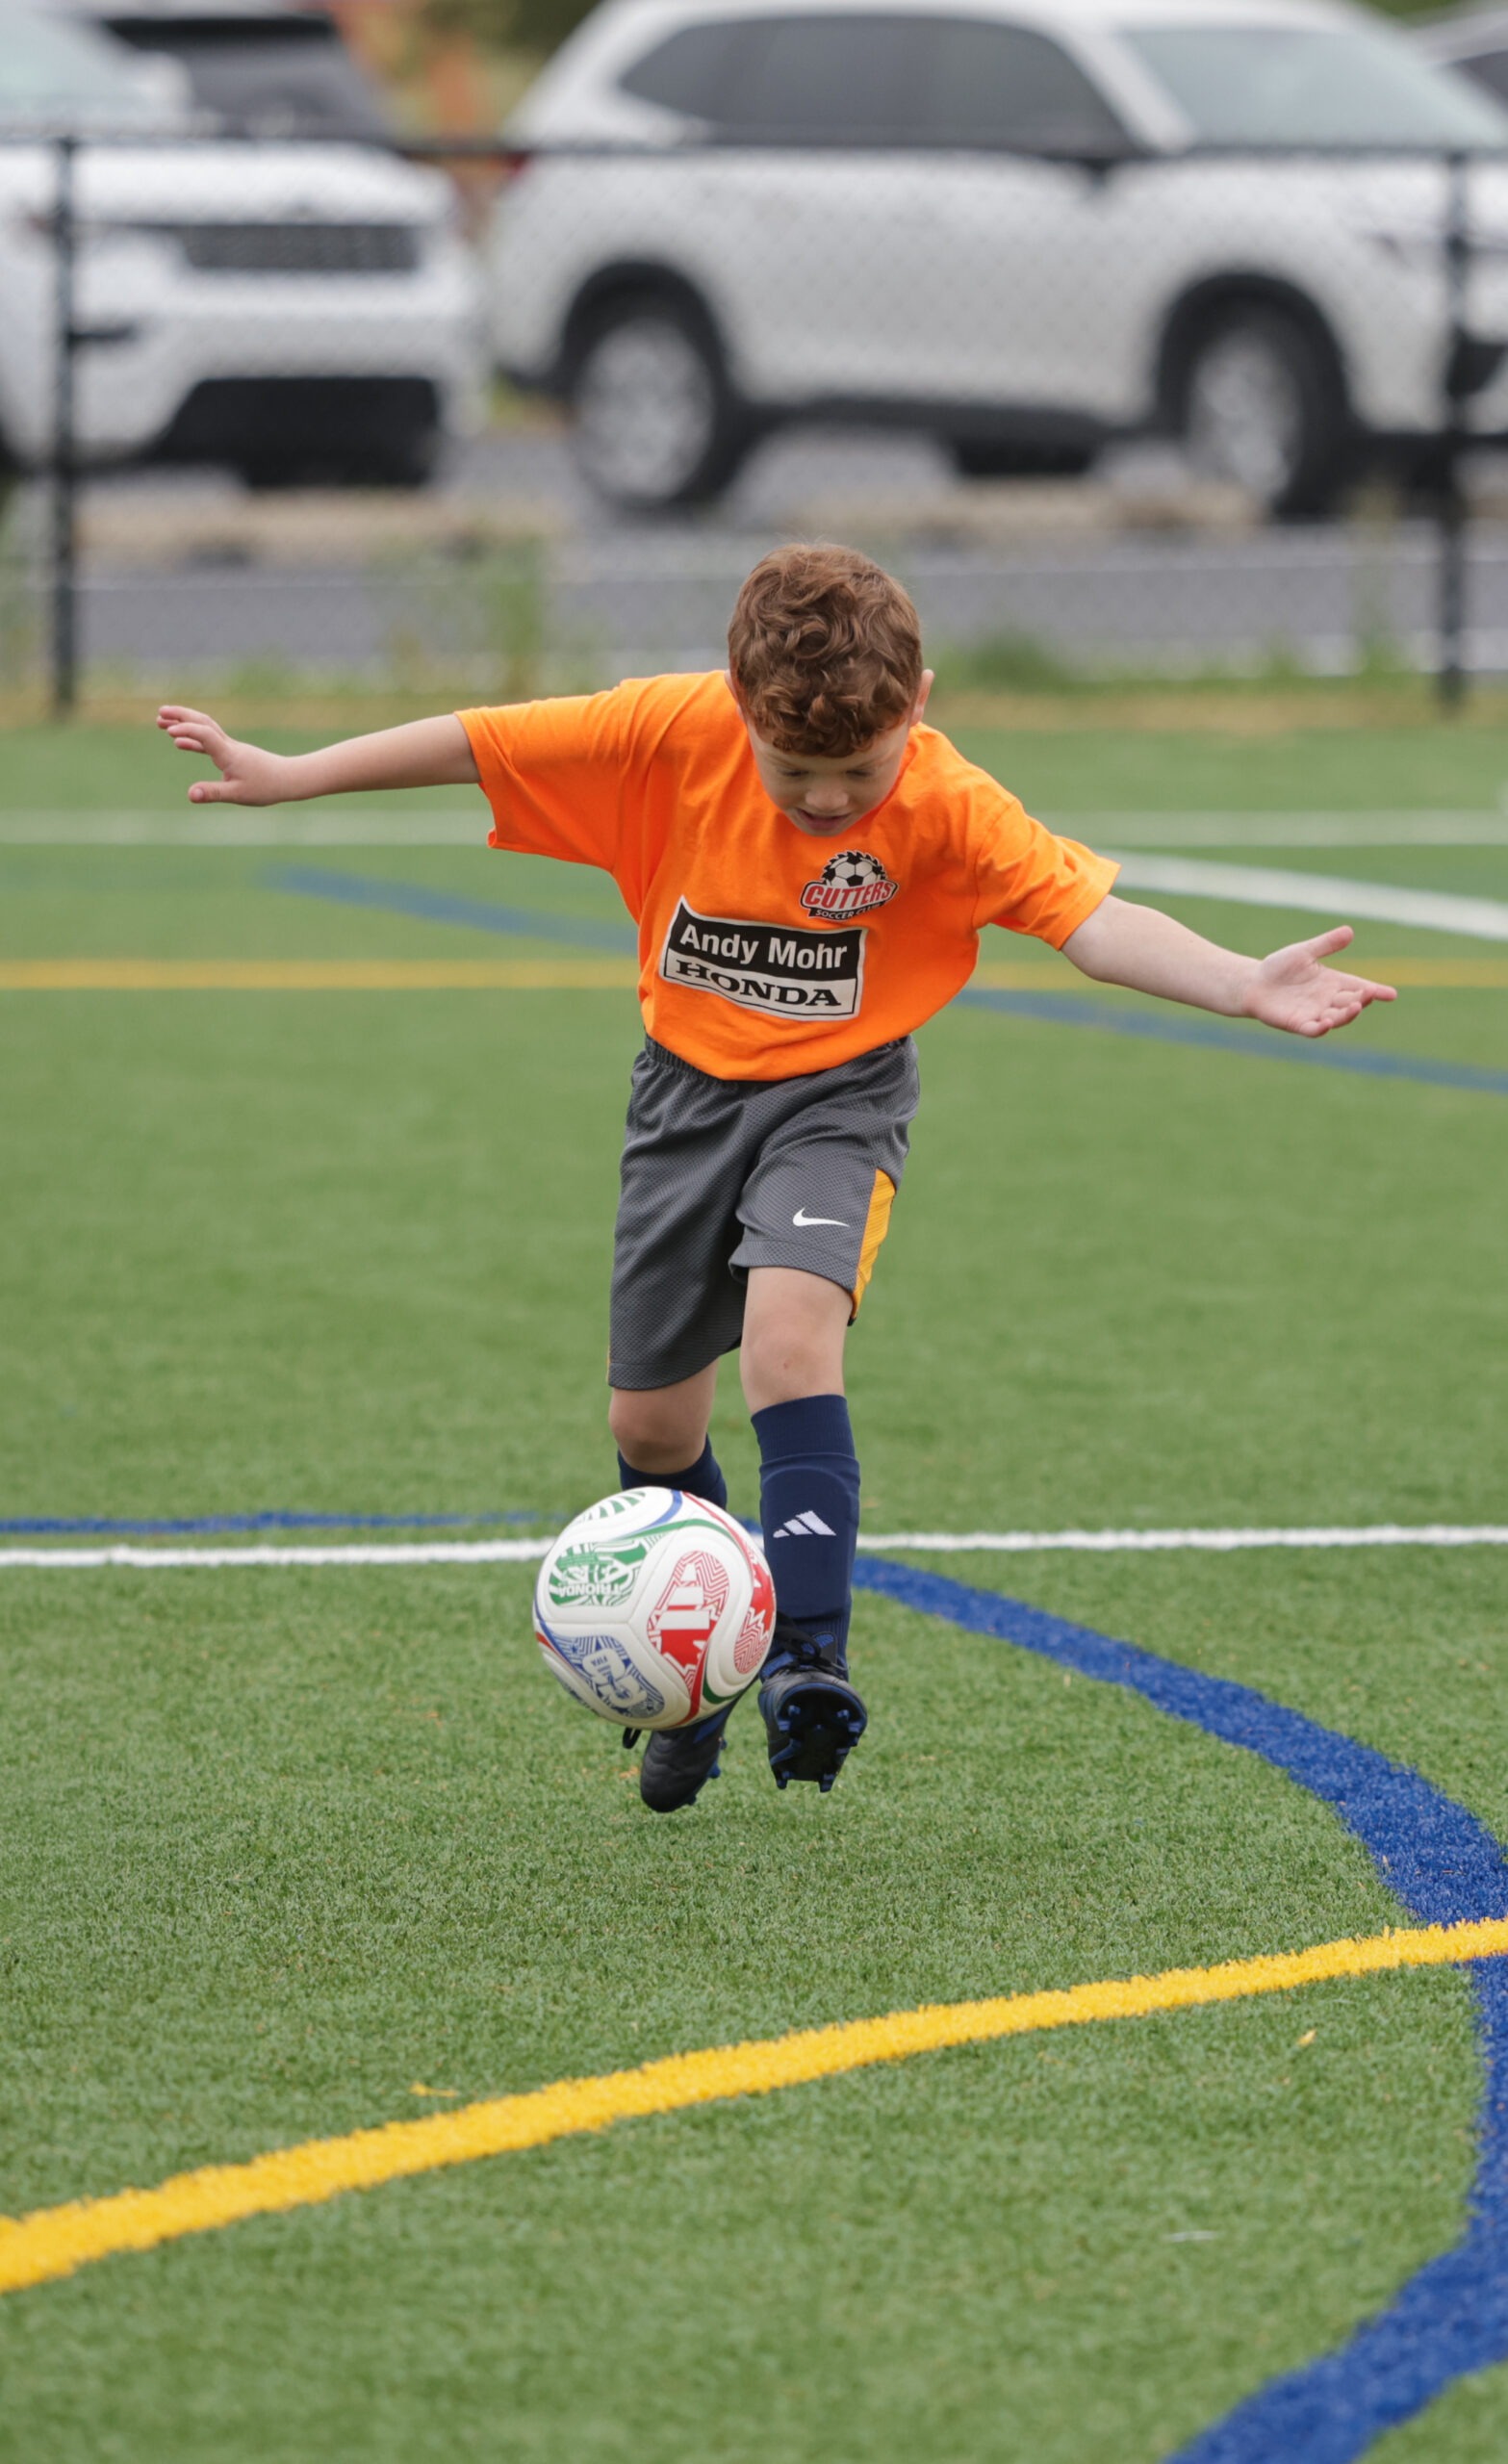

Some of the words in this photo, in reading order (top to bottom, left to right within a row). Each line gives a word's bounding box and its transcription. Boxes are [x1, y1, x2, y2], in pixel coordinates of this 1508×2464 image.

[805, 881, 892, 909] CUTTERS
[815, 910, 855, 920] SOCCER
[679, 924, 758, 964] Andy
[768, 937, 847, 970] Mohr
[676, 961, 841, 1006] HONDA
[560, 1582, 622, 1598] TRIONDA
